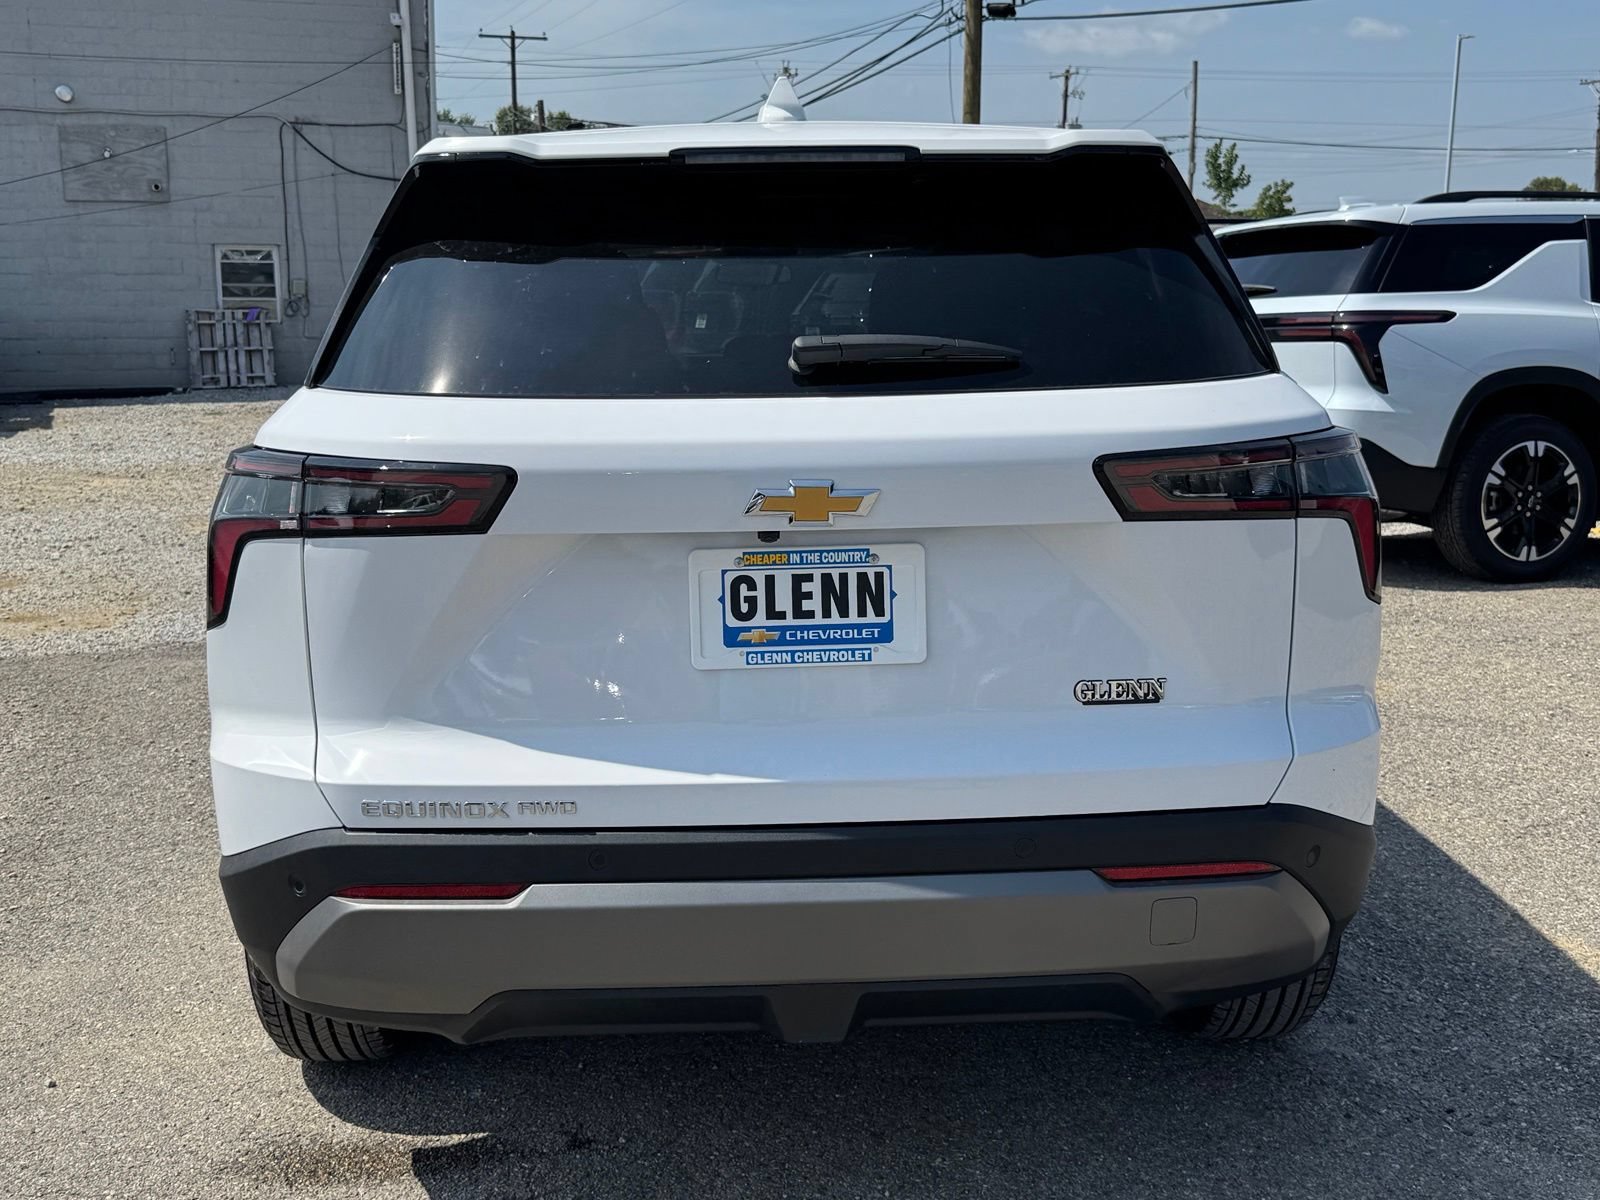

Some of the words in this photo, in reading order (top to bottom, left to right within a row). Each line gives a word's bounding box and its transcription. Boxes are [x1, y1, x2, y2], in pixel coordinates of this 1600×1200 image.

[744, 554, 788, 565] CHEAPER
[790, 554, 800, 564] IN
[801, 553, 820, 563] THE
[822, 551, 869, 563] COUNTRY.
[730, 571, 885, 622] GLENN
[786, 629, 881, 641] CHEVROLET
[748, 652, 791, 664] GLENN
[794, 649, 871, 662] CHEVROLET
[1074, 678, 1167, 703] GLENN
[361, 800, 510, 819] EQUINOX
[517, 801, 577, 816] AWD
